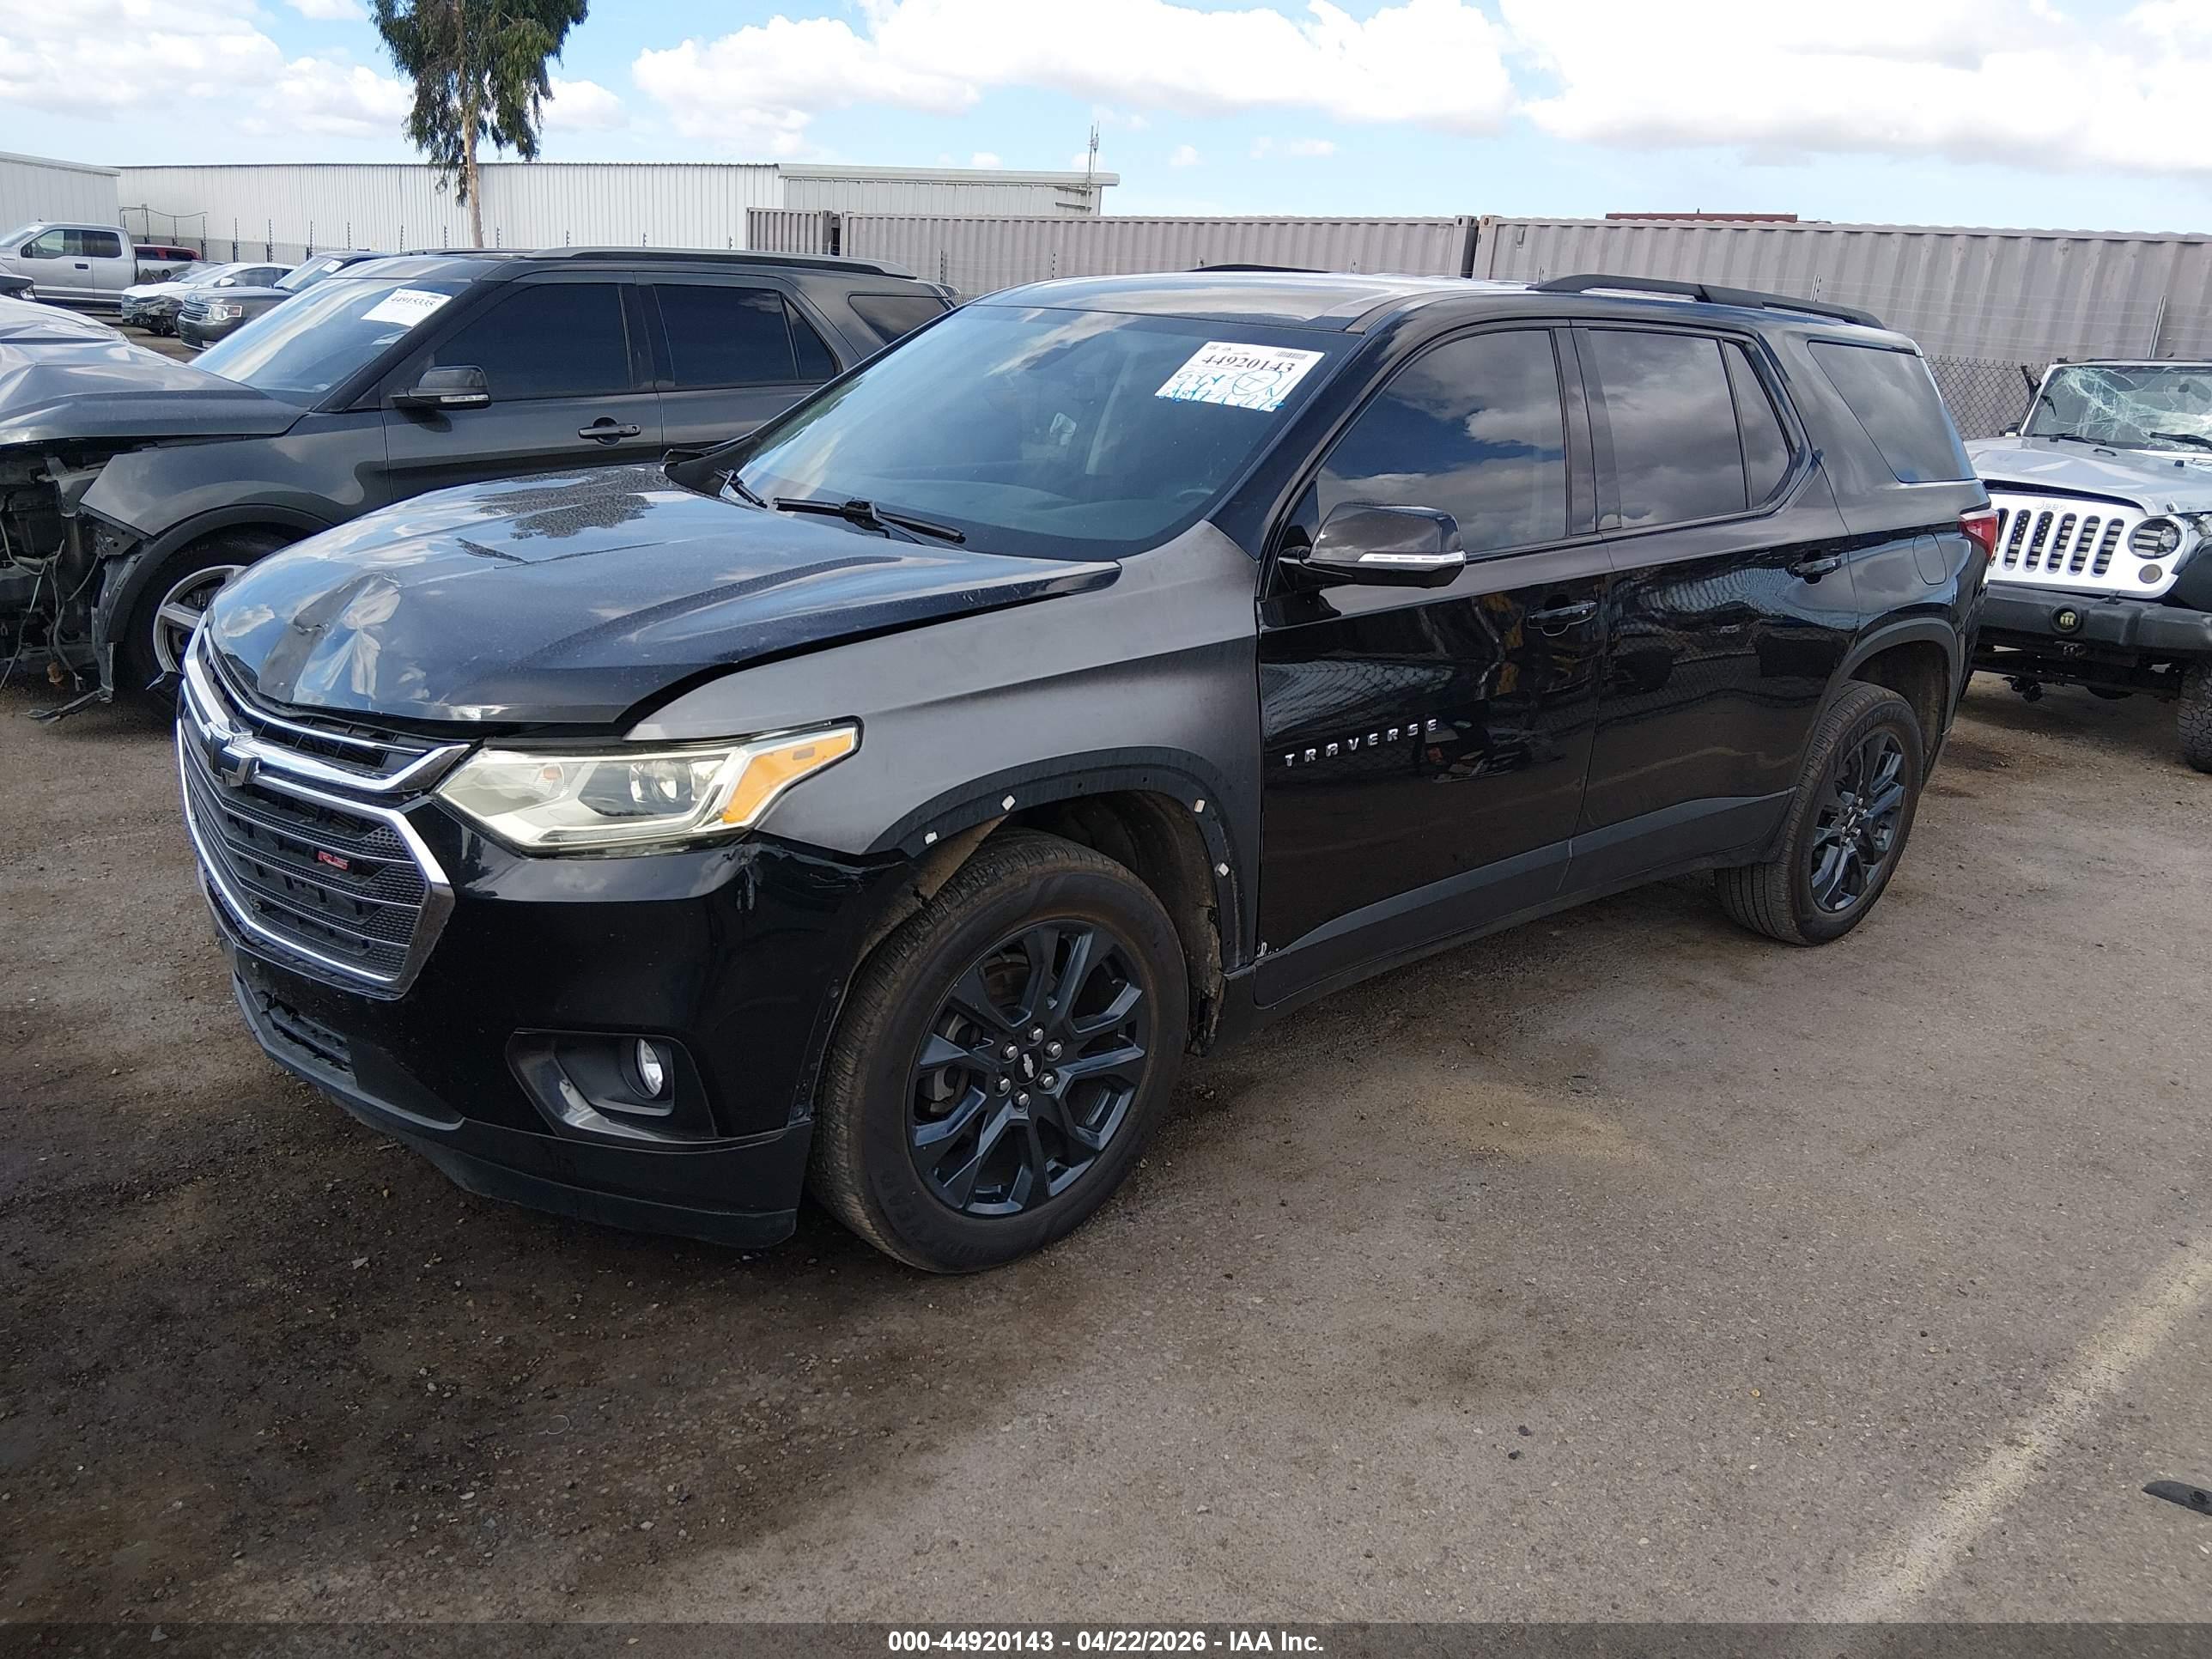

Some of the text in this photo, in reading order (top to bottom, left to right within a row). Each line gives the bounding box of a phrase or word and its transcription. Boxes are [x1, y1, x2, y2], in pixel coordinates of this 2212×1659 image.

[1201, 354, 1296, 374] 44920143
[1285, 719, 1437, 767] TRAVERSE
[318, 850, 349, 870] RS
